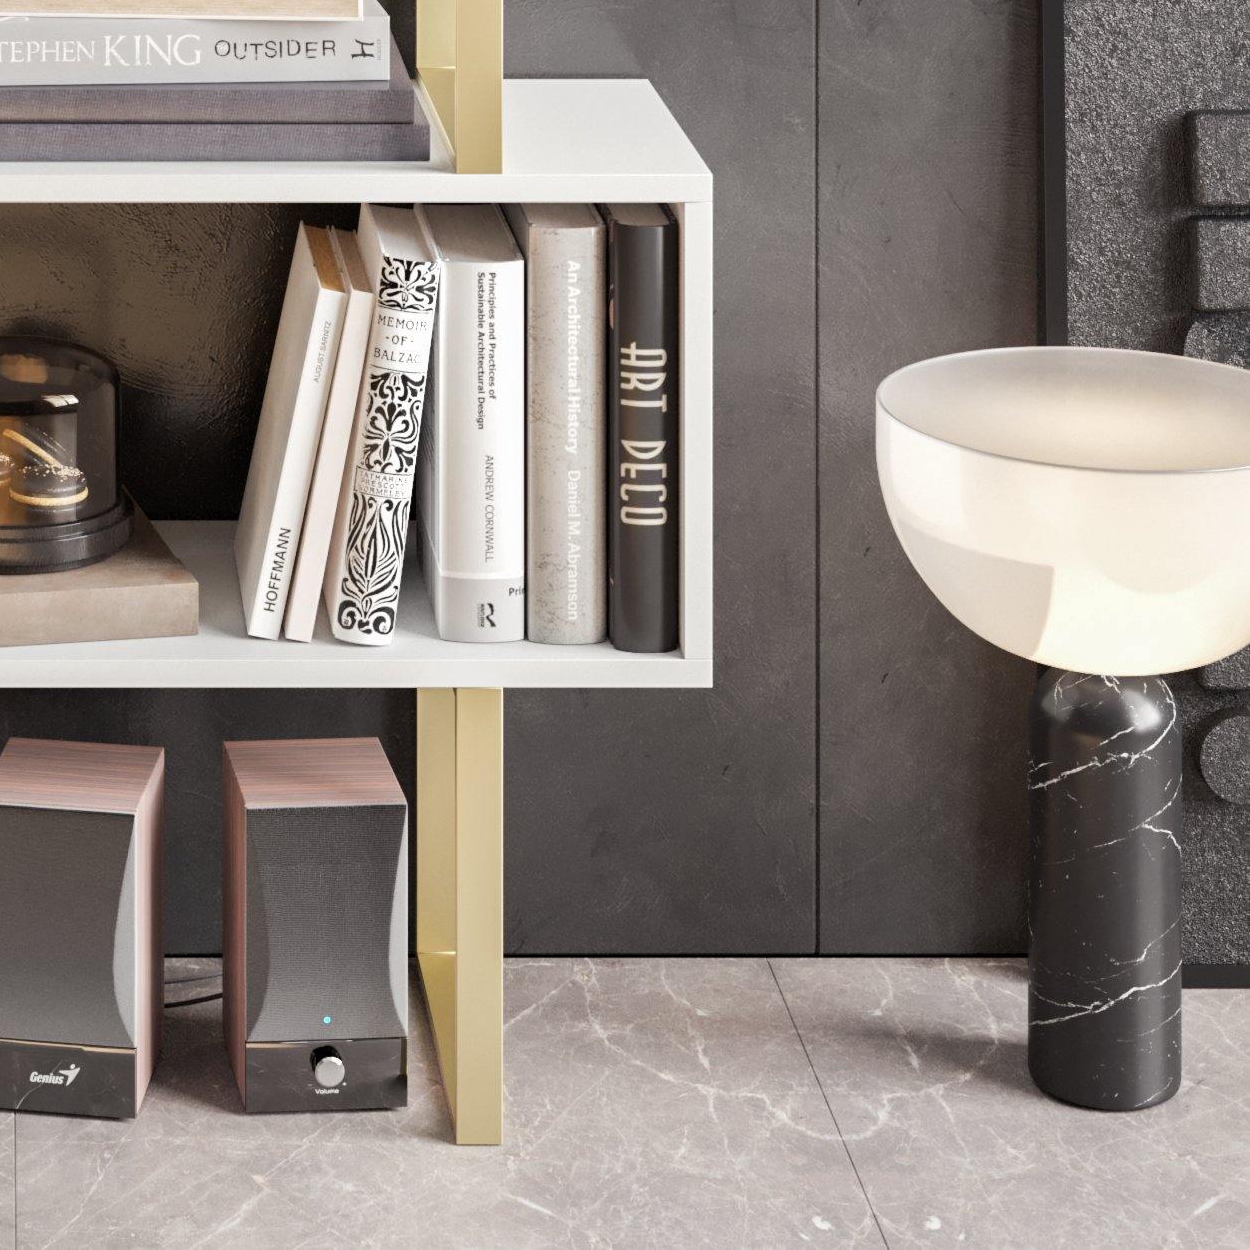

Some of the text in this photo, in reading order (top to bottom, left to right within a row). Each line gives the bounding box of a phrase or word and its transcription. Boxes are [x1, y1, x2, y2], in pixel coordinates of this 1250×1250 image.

[102, 34, 202, 67] KING
[214, 38, 337, 60] OUTSIDER
[374, 348, 421, 364] BALZAC
[378, 315, 427, 331] MEMOIR
[476, 272, 486, 430] Sustainable Architectural Design
[488, 272, 496, 399] Principles and Practices of
[312, 354, 325, 383] AUGUST
[565, 260, 582, 620] An Architectural History Daniel M. Abramson
[620, 341, 667, 526] ART DECO
[485, 455, 494, 563] ANDREW CORNWALL
[264, 527, 291, 612] HOFFMANN
[30, 1071, 64, 1085] Genius
